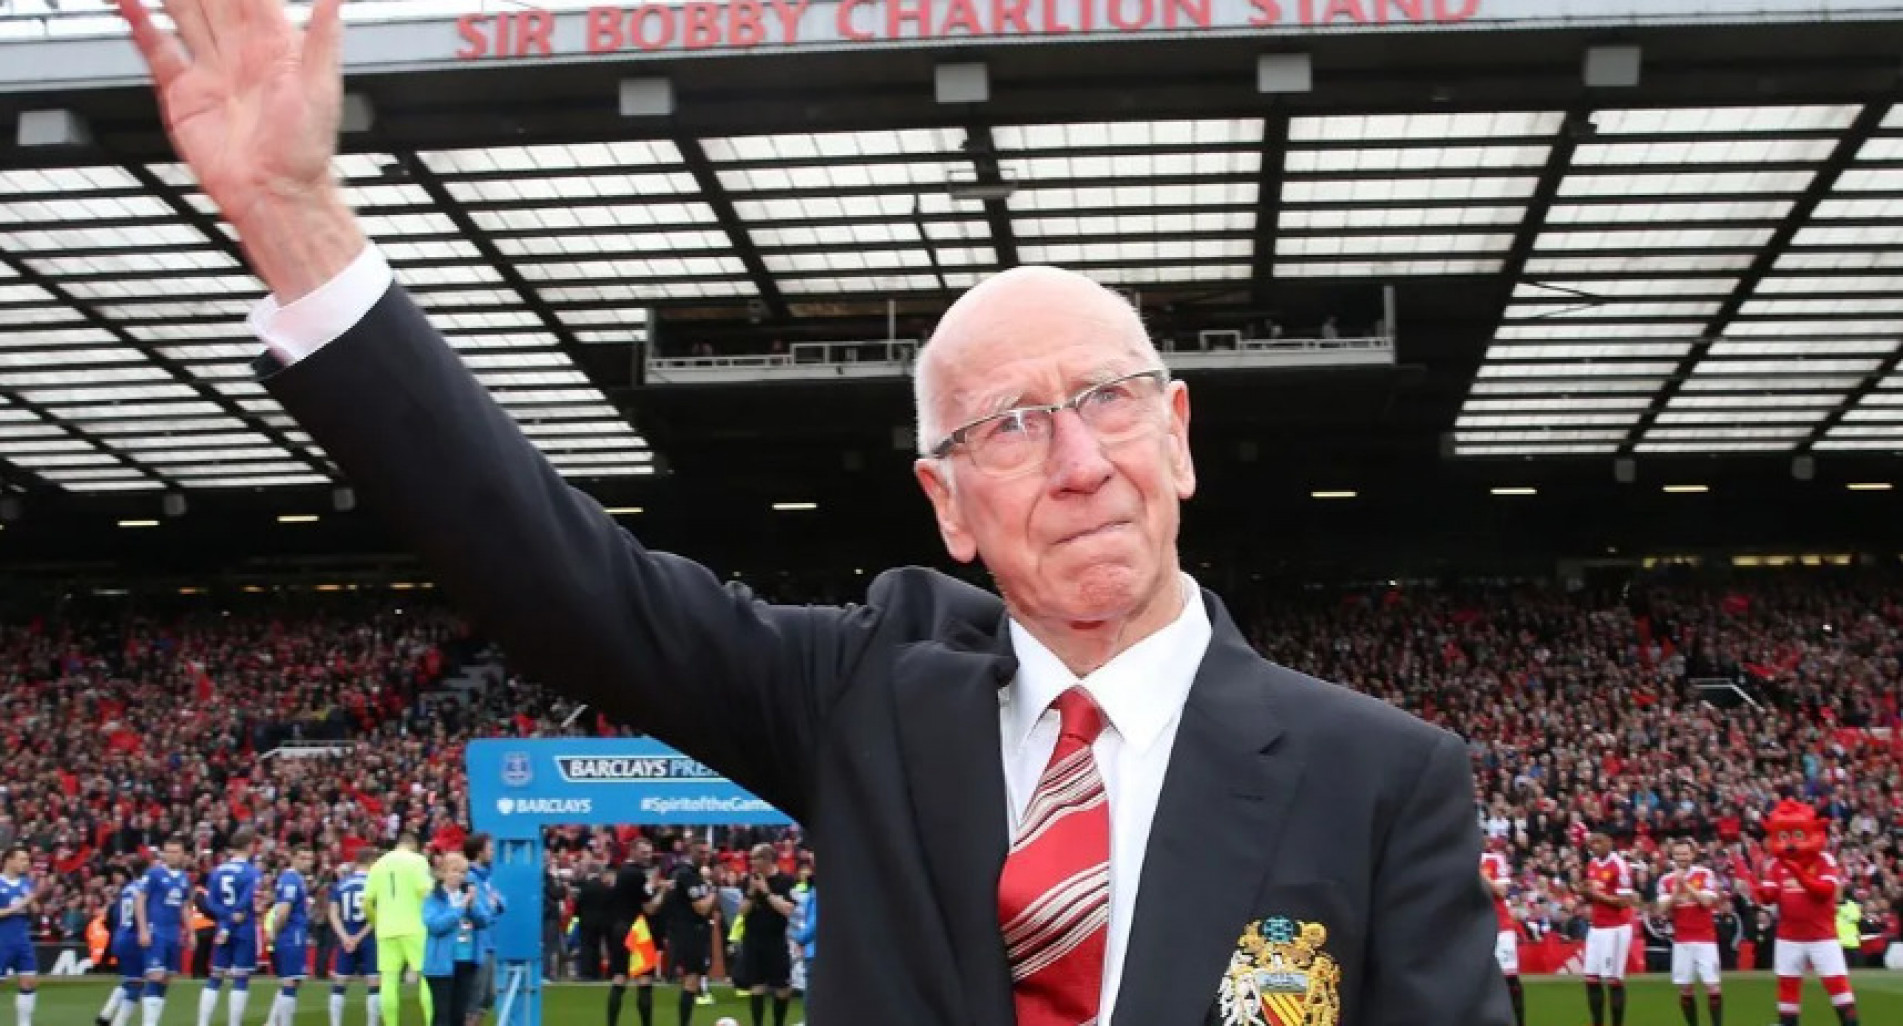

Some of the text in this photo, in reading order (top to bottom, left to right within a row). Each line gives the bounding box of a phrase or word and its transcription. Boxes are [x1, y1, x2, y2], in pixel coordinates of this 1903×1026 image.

[456, 10, 554, 60] SIR
[587, 0, 809, 55] BOBBY
[571, 758, 719, 778] BARCLAYS PRE
[517, 797, 592, 814] BARCLAYS
[221, 874, 236, 906] 5
[341, 890, 367, 922] 15
